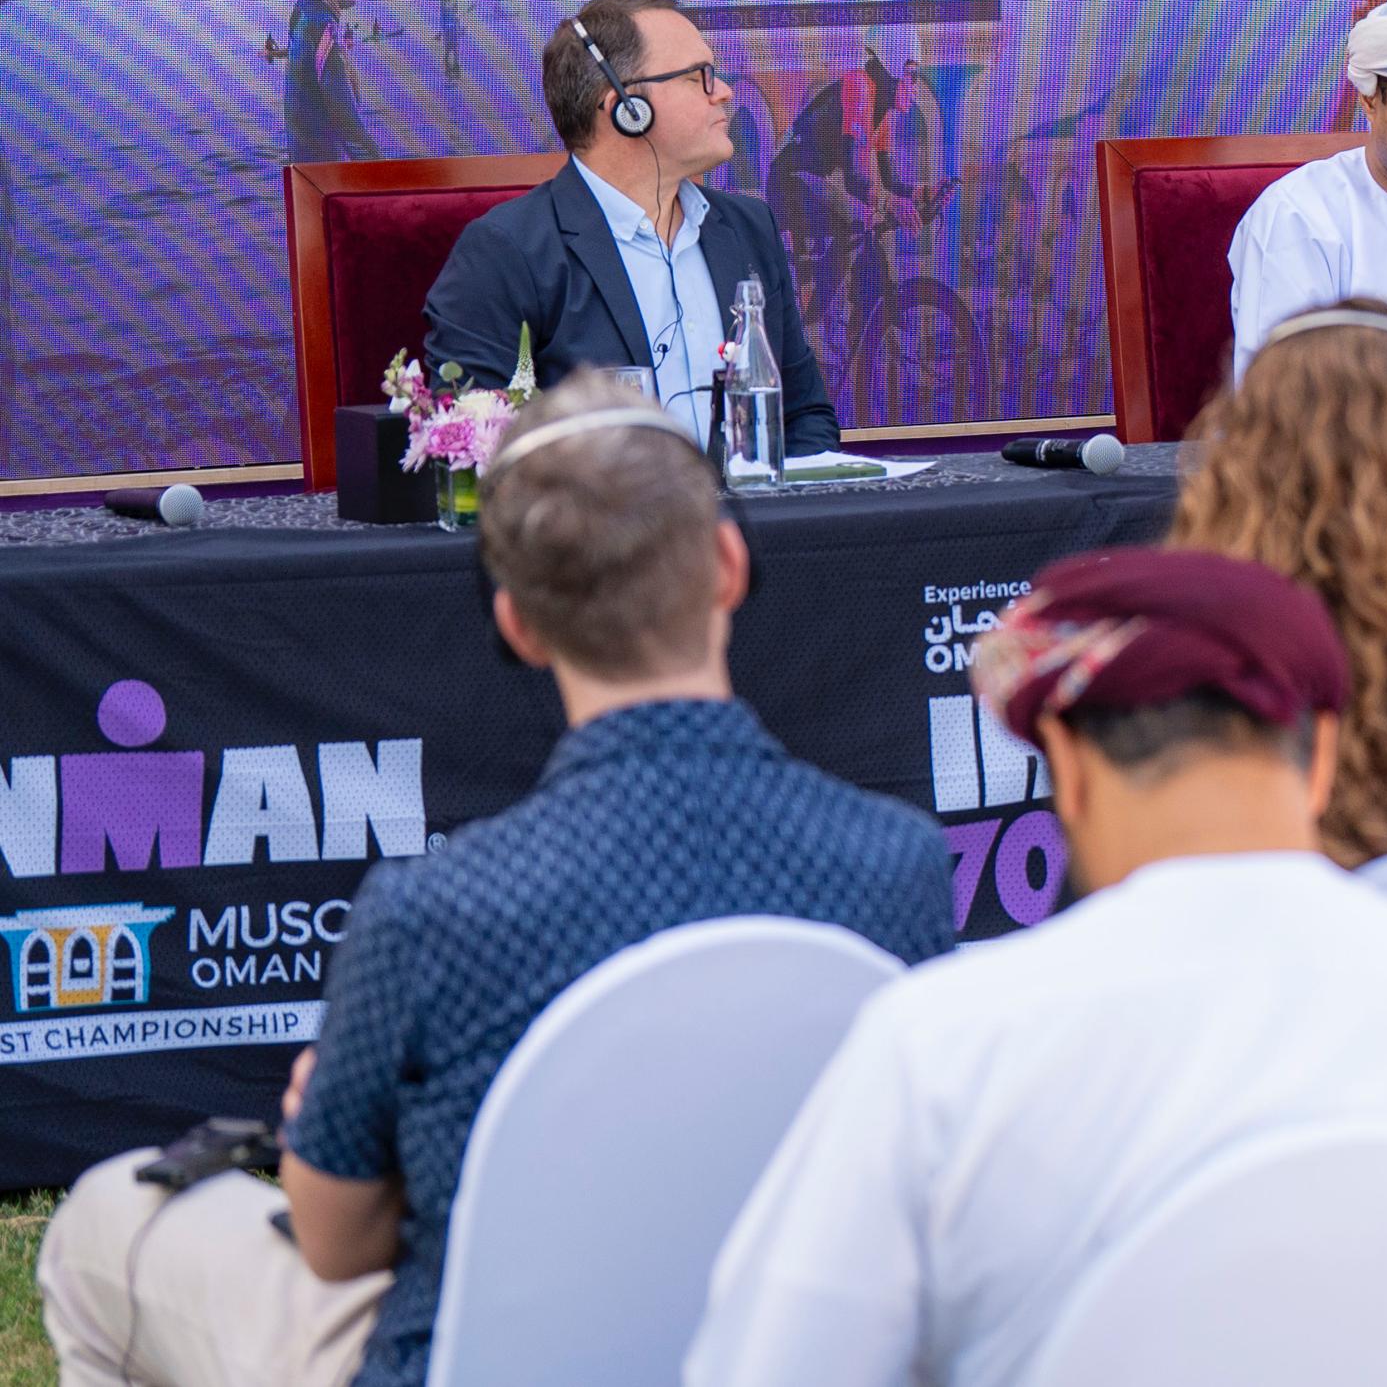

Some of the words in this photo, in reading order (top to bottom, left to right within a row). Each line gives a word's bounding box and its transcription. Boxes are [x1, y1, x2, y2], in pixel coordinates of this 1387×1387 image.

[924, 581, 1032, 604] Experience
[192, 953, 320, 989] OMAN
[45, 1012, 300, 1049] CHAMPIONSHIP
